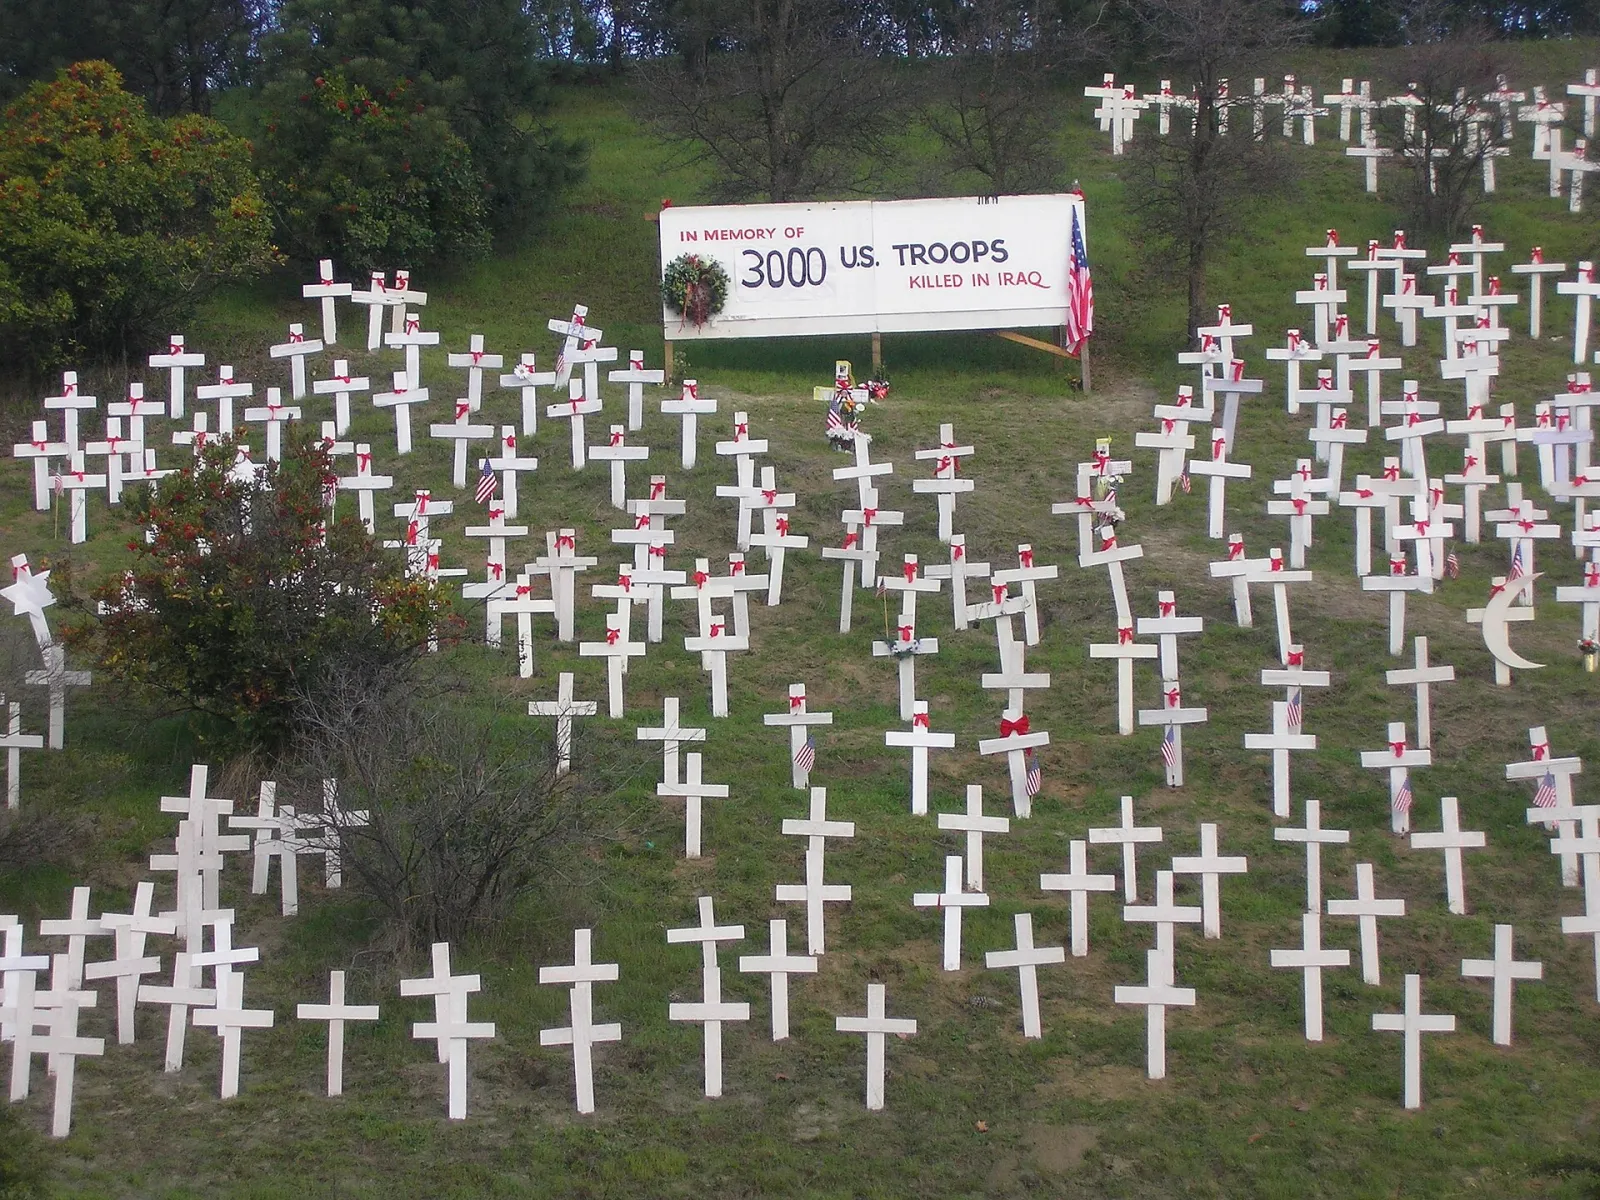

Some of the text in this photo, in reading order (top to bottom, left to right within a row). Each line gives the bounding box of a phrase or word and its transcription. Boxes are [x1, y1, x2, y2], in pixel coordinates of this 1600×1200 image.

[680, 226, 805, 242] IN MEMORY OF
[840, 239, 1009, 269] U.S. TROOPS
[741, 246, 827, 289] 3000
[909, 271, 1051, 289] KILLED IN IRAQ
